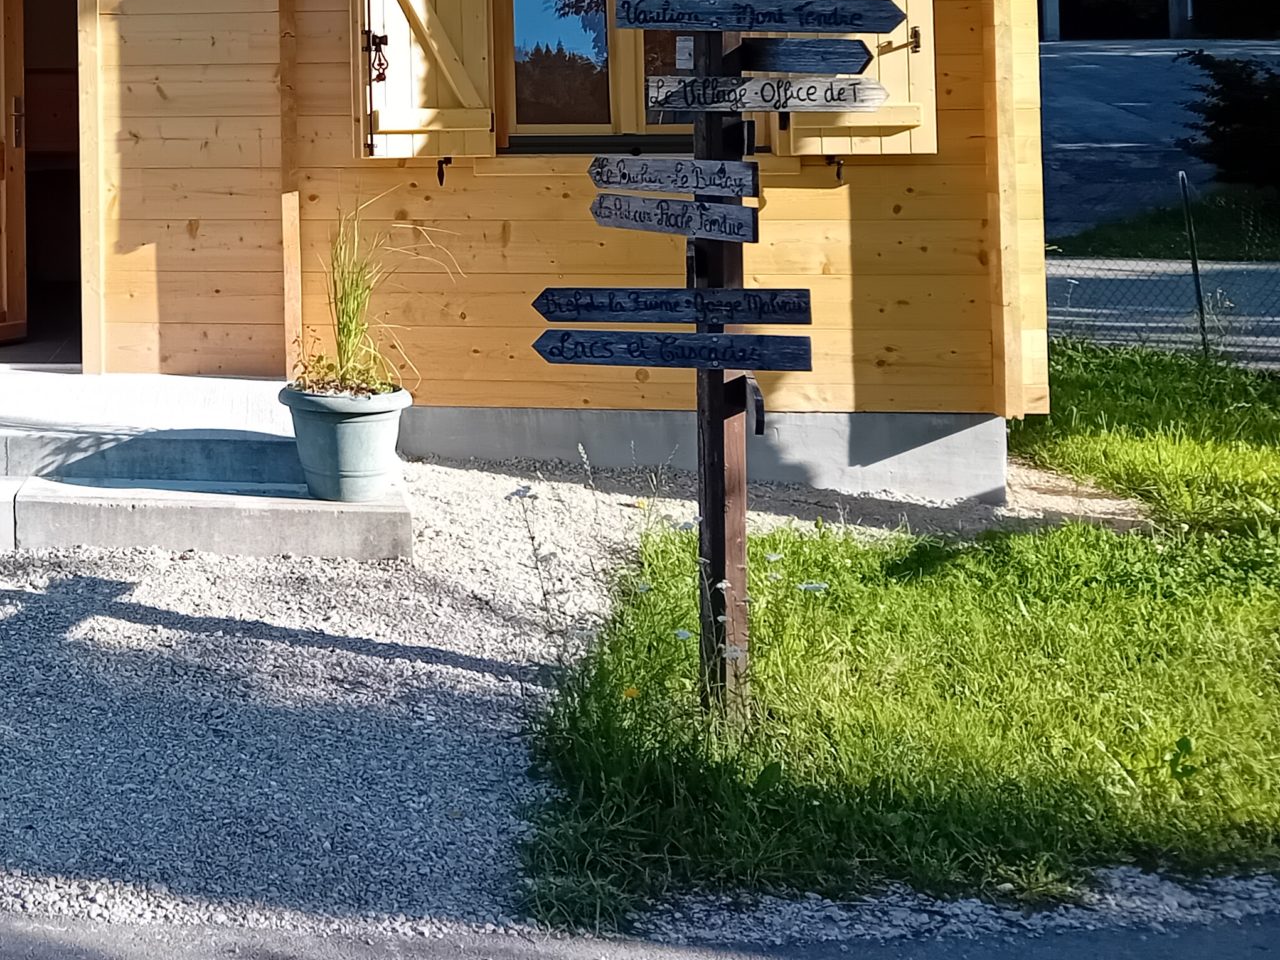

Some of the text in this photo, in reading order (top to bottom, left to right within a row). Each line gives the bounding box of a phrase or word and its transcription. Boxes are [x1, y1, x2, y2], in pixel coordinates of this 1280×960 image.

[650, 79, 672, 105] Le
[678, 78, 748, 112] Village
[760, 82, 817, 110] Office
[548, 331, 616, 361] Lacs
